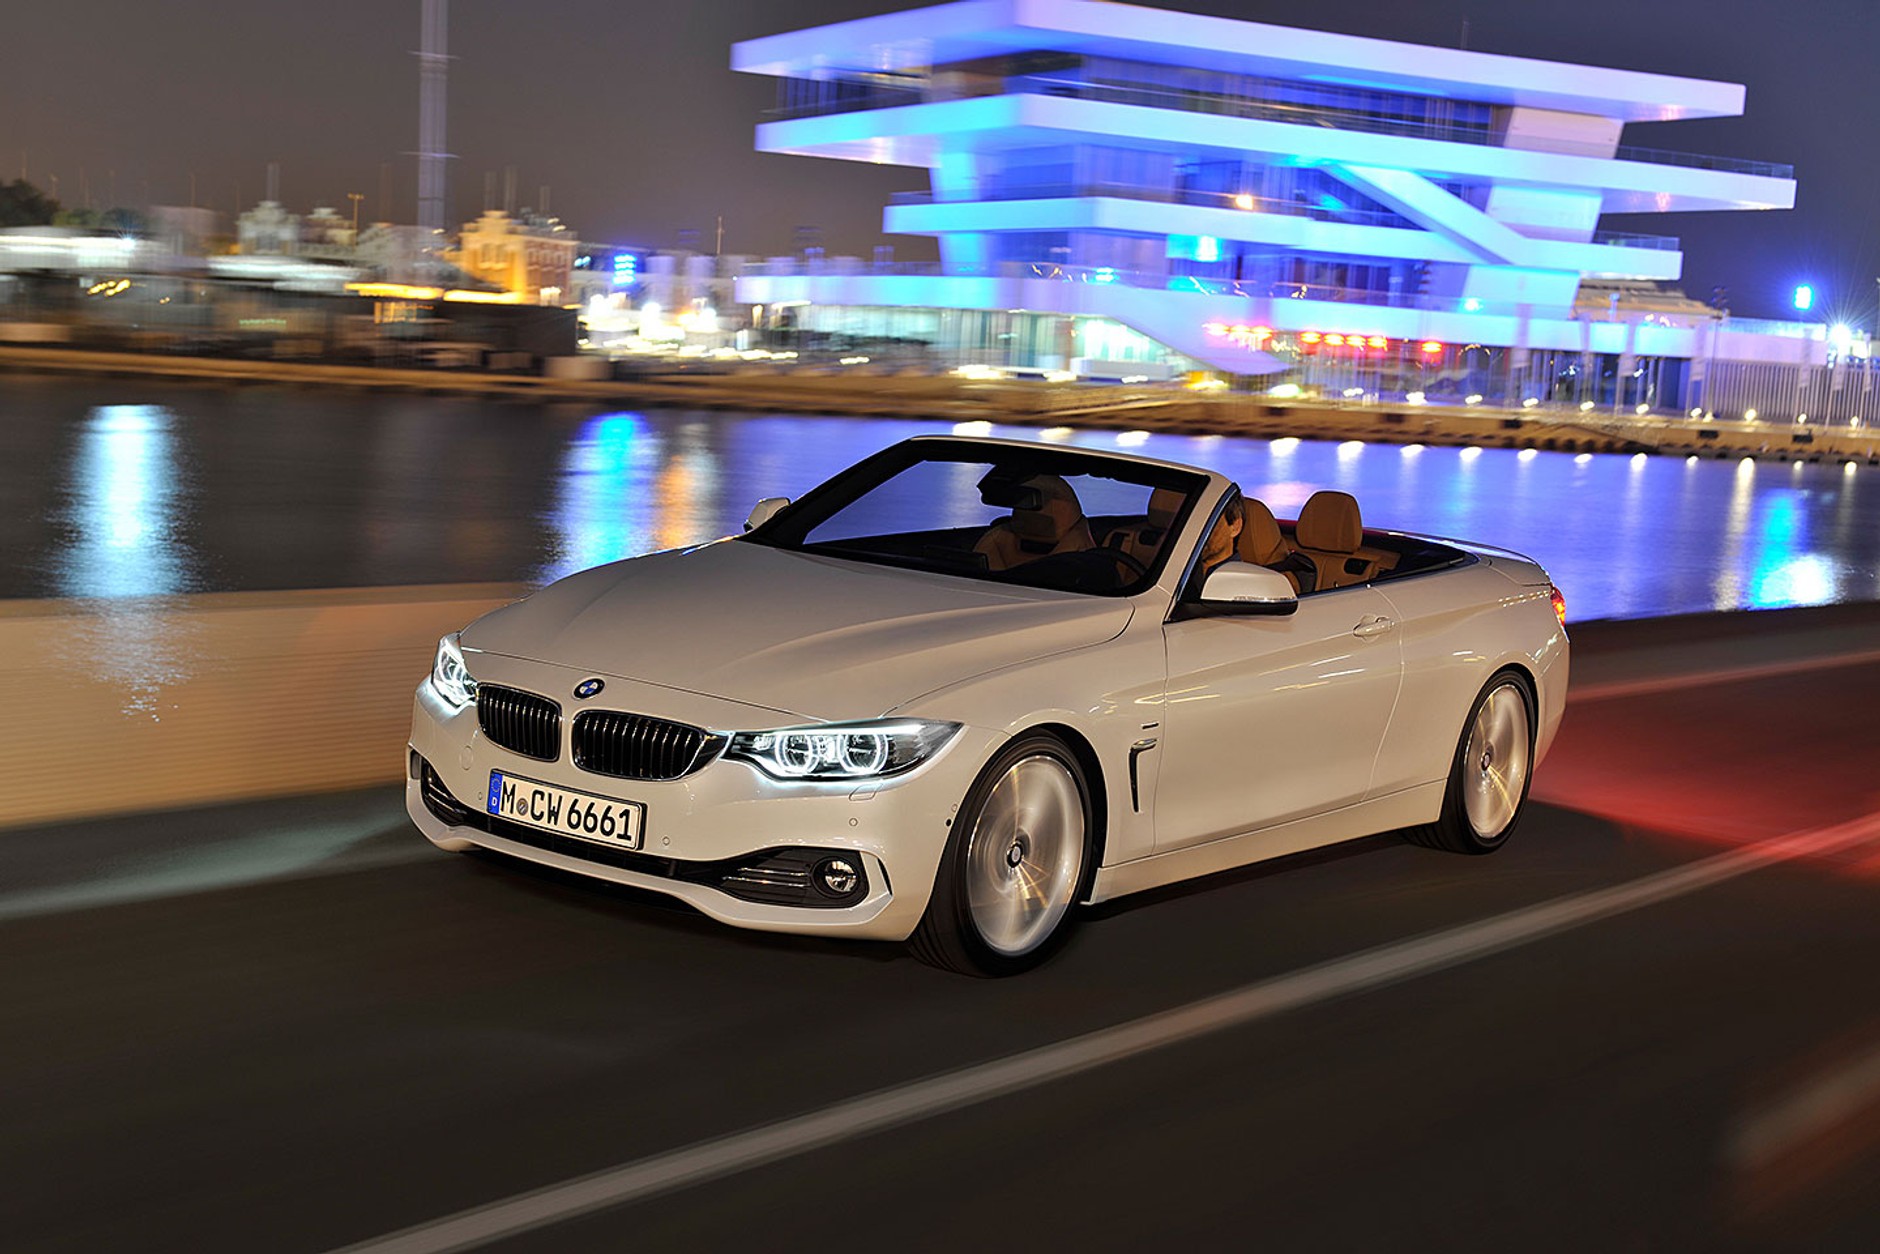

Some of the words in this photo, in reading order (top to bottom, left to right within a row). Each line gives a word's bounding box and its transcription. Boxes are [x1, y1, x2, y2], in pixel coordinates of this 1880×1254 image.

[491, 797, 498, 806] D
[500, 781, 516, 814] M
[530, 790, 563, 826] CW
[567, 798, 632, 841] 6661
